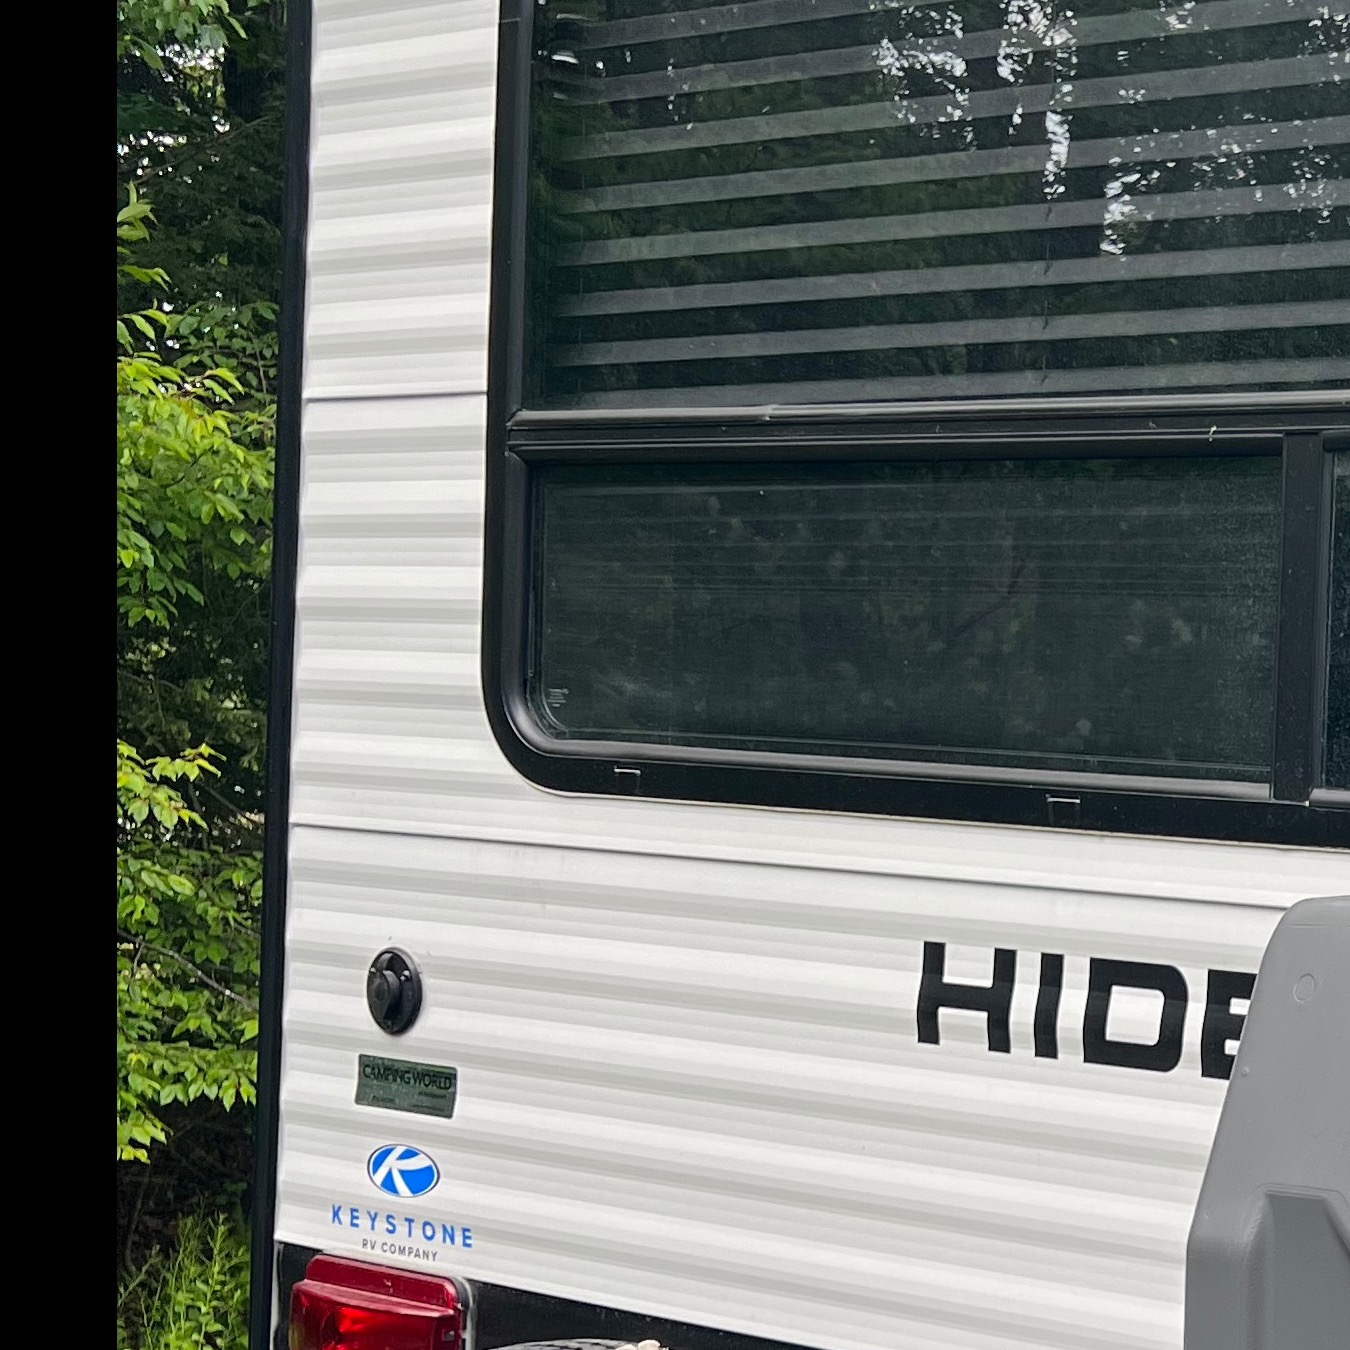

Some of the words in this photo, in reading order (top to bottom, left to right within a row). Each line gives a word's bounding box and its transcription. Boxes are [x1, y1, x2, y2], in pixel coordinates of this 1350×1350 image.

[363, 1063, 411, 1085] CAMPING
[412, 1071, 453, 1090] WORLD
[331, 1204, 474, 1248] KEYSTONE
[361, 1238, 379, 1251] RV
[381, 1242, 439, 1262] COMPANY
